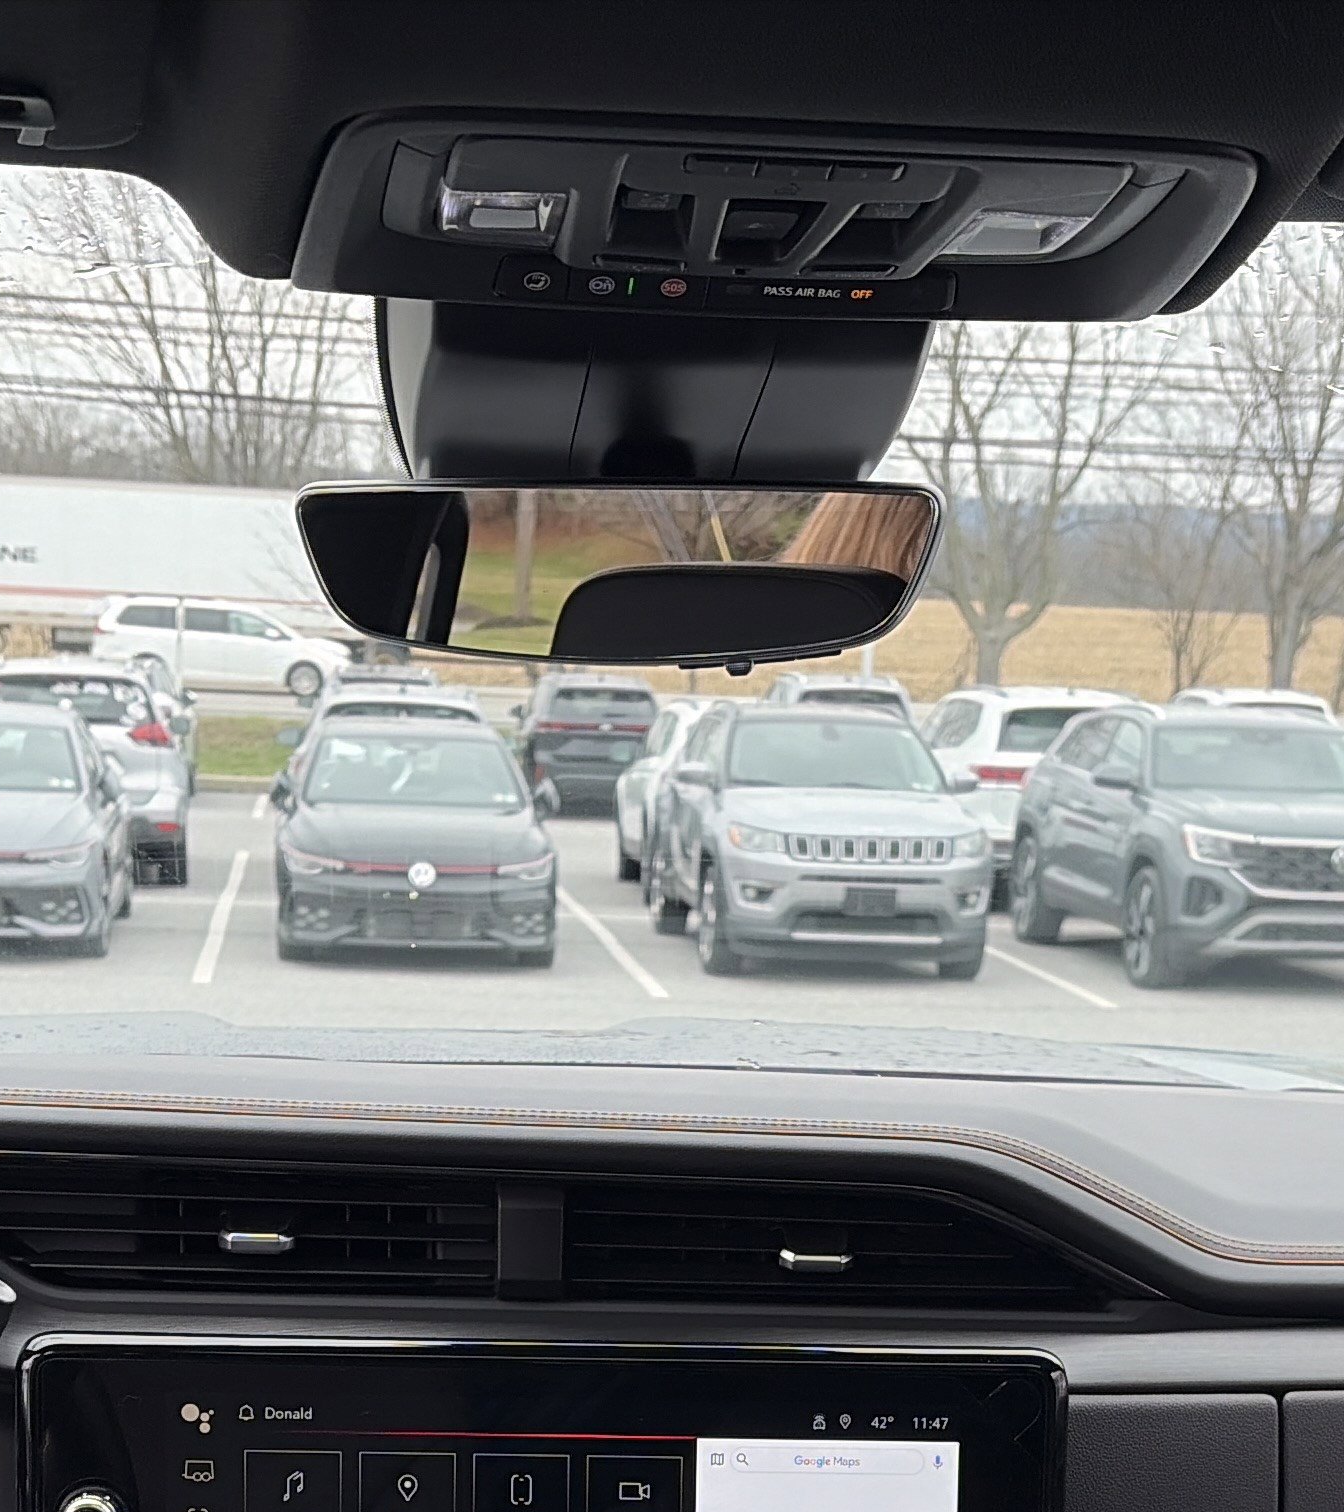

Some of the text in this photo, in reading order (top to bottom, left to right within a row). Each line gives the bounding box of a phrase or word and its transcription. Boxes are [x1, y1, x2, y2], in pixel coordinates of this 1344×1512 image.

[664, 283, 684, 293] SOS
[764, 286, 873, 299] PASS AIR BAG OFF
[265, 1407, 312, 1420] Donald
[871, 1416, 948, 1430] 42° 11:47
[794, 1455, 860, 1468] Google Maps
